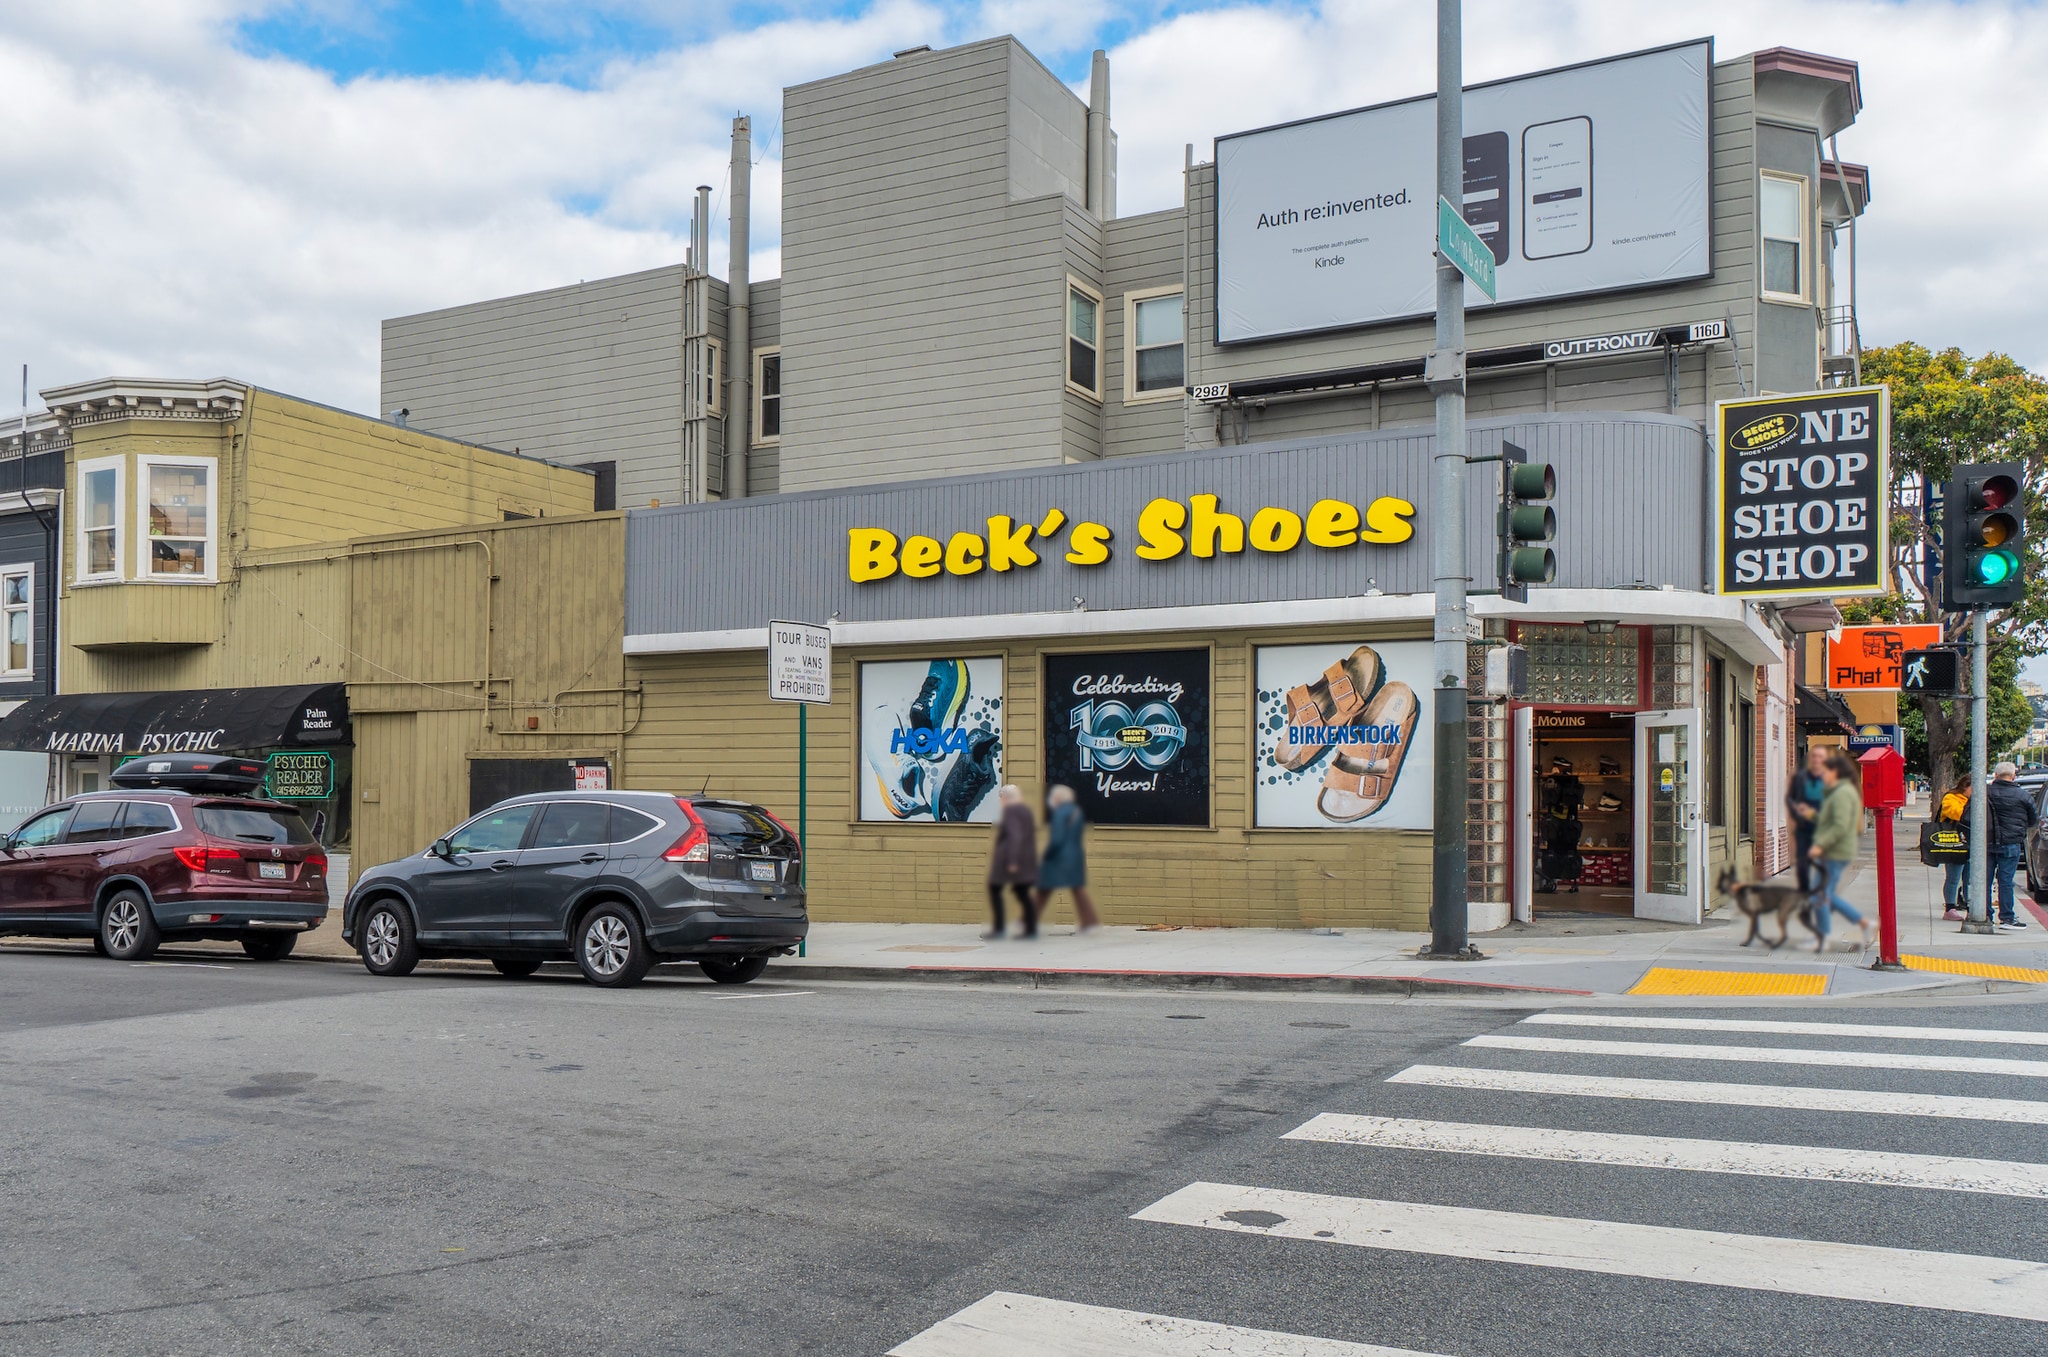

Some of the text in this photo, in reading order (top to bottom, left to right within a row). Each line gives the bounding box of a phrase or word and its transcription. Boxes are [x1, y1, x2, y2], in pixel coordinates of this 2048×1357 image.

[1257, 188, 1412, 229] Auth re:invented.
[1303, 243, 1330, 253] complete
[1330, 240, 1344, 249] auth
[1344, 237, 1370, 247] platform
[1612, 230, 1677, 246] kinde.com/reinvent
[1449, 221, 1488, 282] Lombard
[1314, 255, 1345, 269] Kinde
[1694, 323, 1720, 338] 1160
[1195, 385, 1227, 398] 2987
[1742, 416, 1785, 439] BECK'S
[1747, 426, 1786, 447] SHOES
[1762, 443, 1779, 453] THAT
[1779, 432, 1798, 446] WORK
[1740, 452, 1869, 495] STOP
[1734, 497, 1867, 540] SHOE
[848, 493, 1418, 585] Beck's Shoes
[1735, 543, 1869, 583] SHOP
[776, 631, 827, 650] TOUR BUSES
[784, 655, 823, 669] AND VANS
[1837, 667, 1882, 685] Phat
[780, 680, 825, 696] PROHIBITED
[1072, 674, 1185, 703] Celebrating
[305, 708, 327, 718] Palm
[1538, 716, 1586, 727] MOVING
[303, 719, 333, 729] Reader
[1153, 725, 1179, 737] 2019
[45, 729, 226, 753] MARINA PSYCHIC
[890, 727, 970, 754] HOKA
[1069, 698, 1182, 772] 100
[1094, 739, 1115, 748] 1919
[1288, 725, 1401, 745] BIRKENSTOCK
[274, 755, 327, 769] PSYCHIC
[276, 770, 323, 785] READER
[585, 769, 606, 779] PARKING
[276, 785, 323, 796] 415-684-2522
[1096, 771, 1159, 798] Years!
